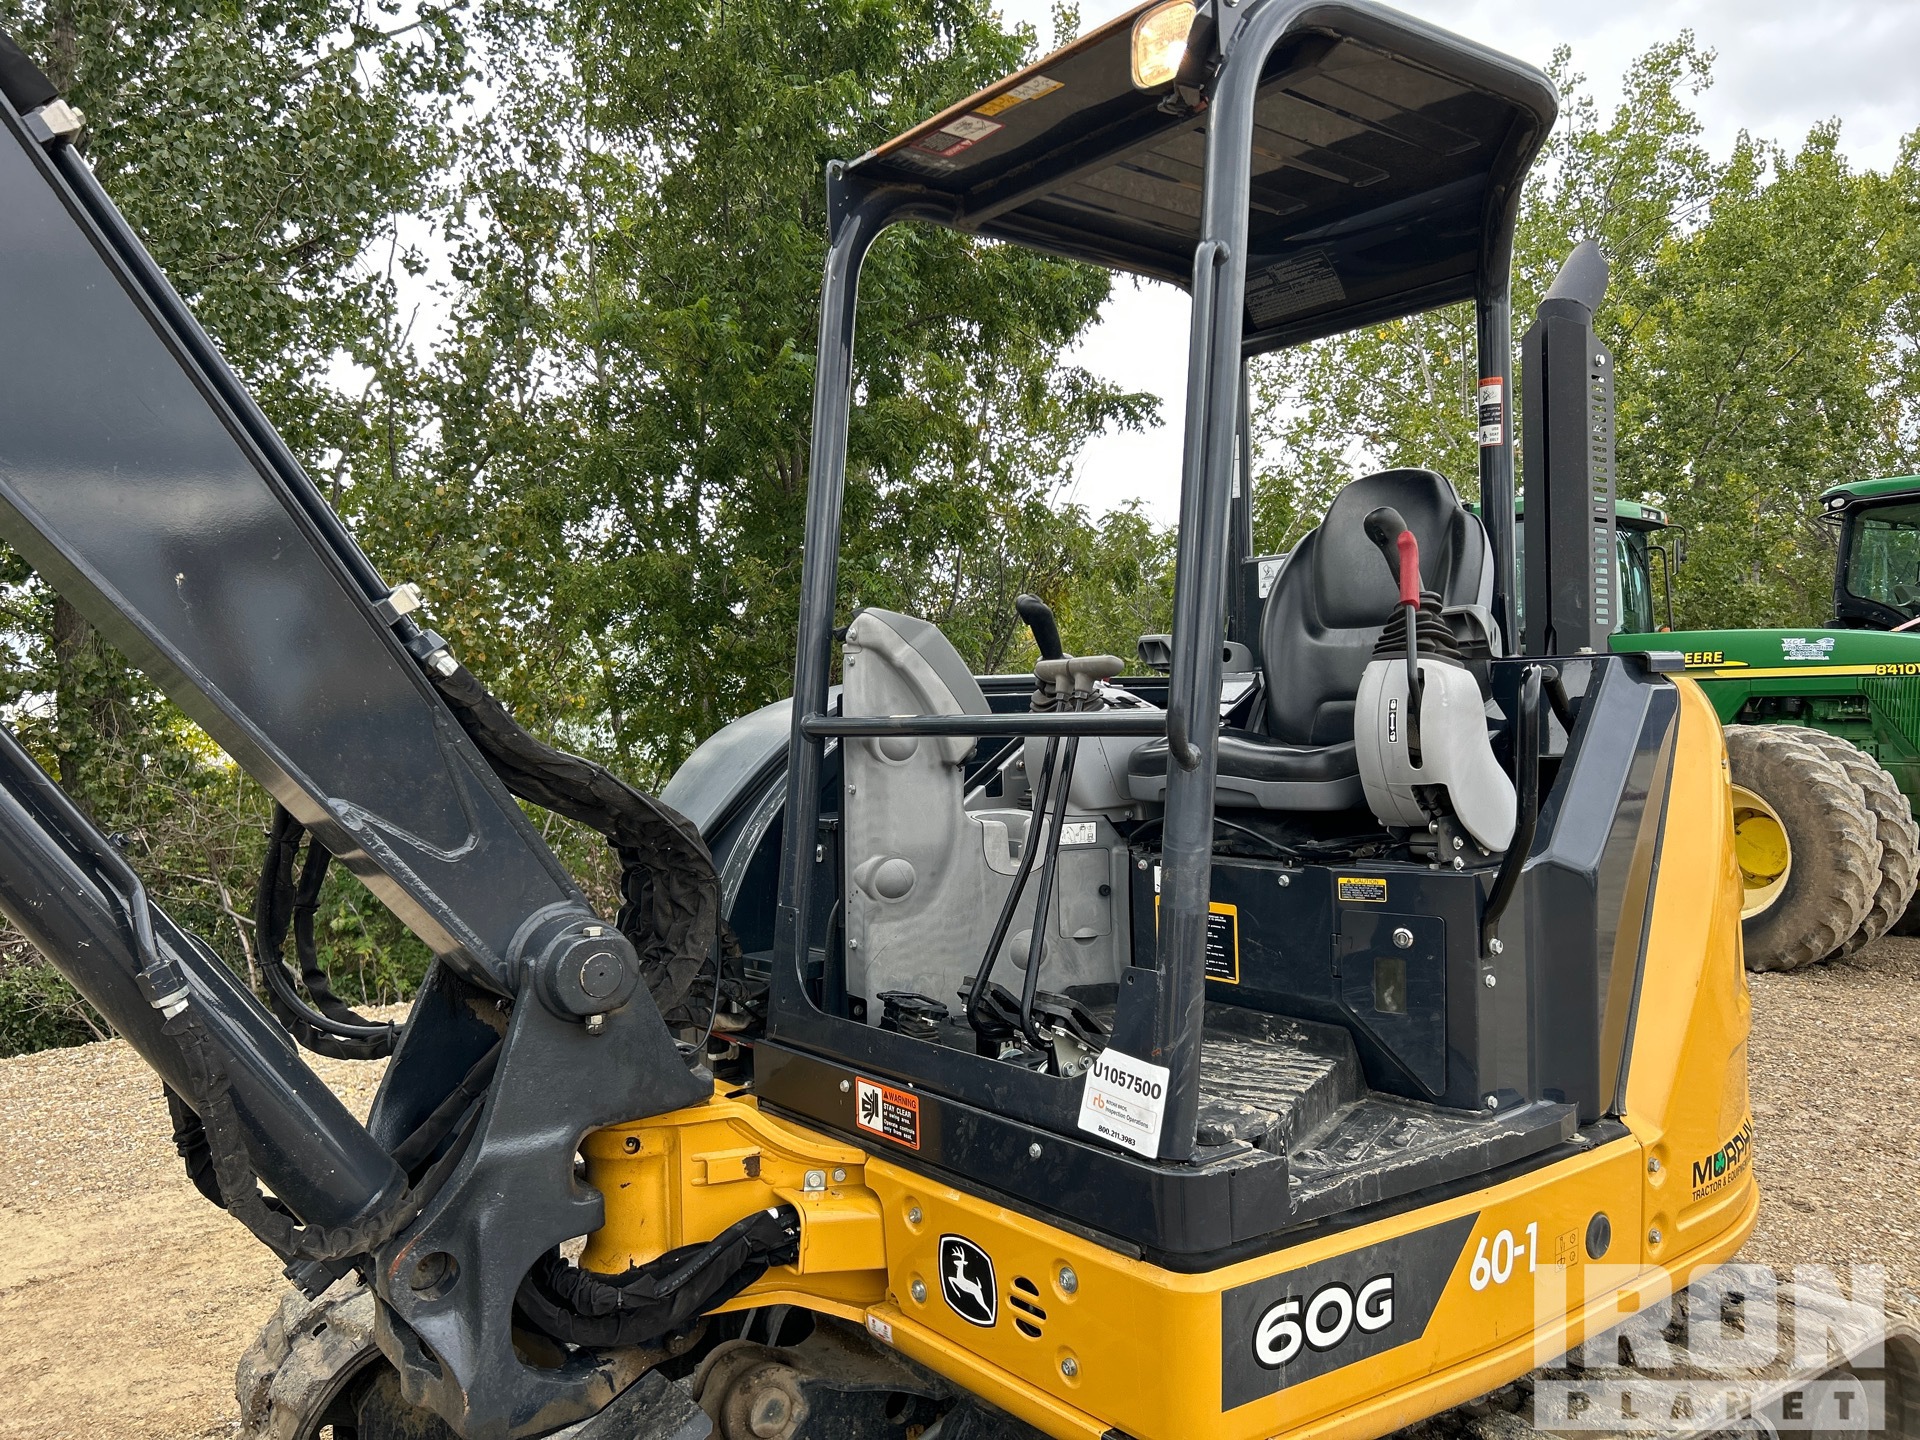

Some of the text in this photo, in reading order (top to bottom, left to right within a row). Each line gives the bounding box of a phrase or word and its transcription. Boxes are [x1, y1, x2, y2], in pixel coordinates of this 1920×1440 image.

[1685, 652, 1723, 664] EERE
[883, 1103, 912, 1118] STAY CLEAR
[889, 1092, 916, 1108] WARNING
[1105, 1106, 1149, 1129] Inspection Operations
[1098, 1125, 1136, 1146] 800.211.3983
[1692, 1179, 1722, 1201] TRACTOR
[1723, 1176, 1727, 1186] &
[1469, 1221, 1538, 1291] 60-1
[1254, 1275, 1393, 1367] 60G
